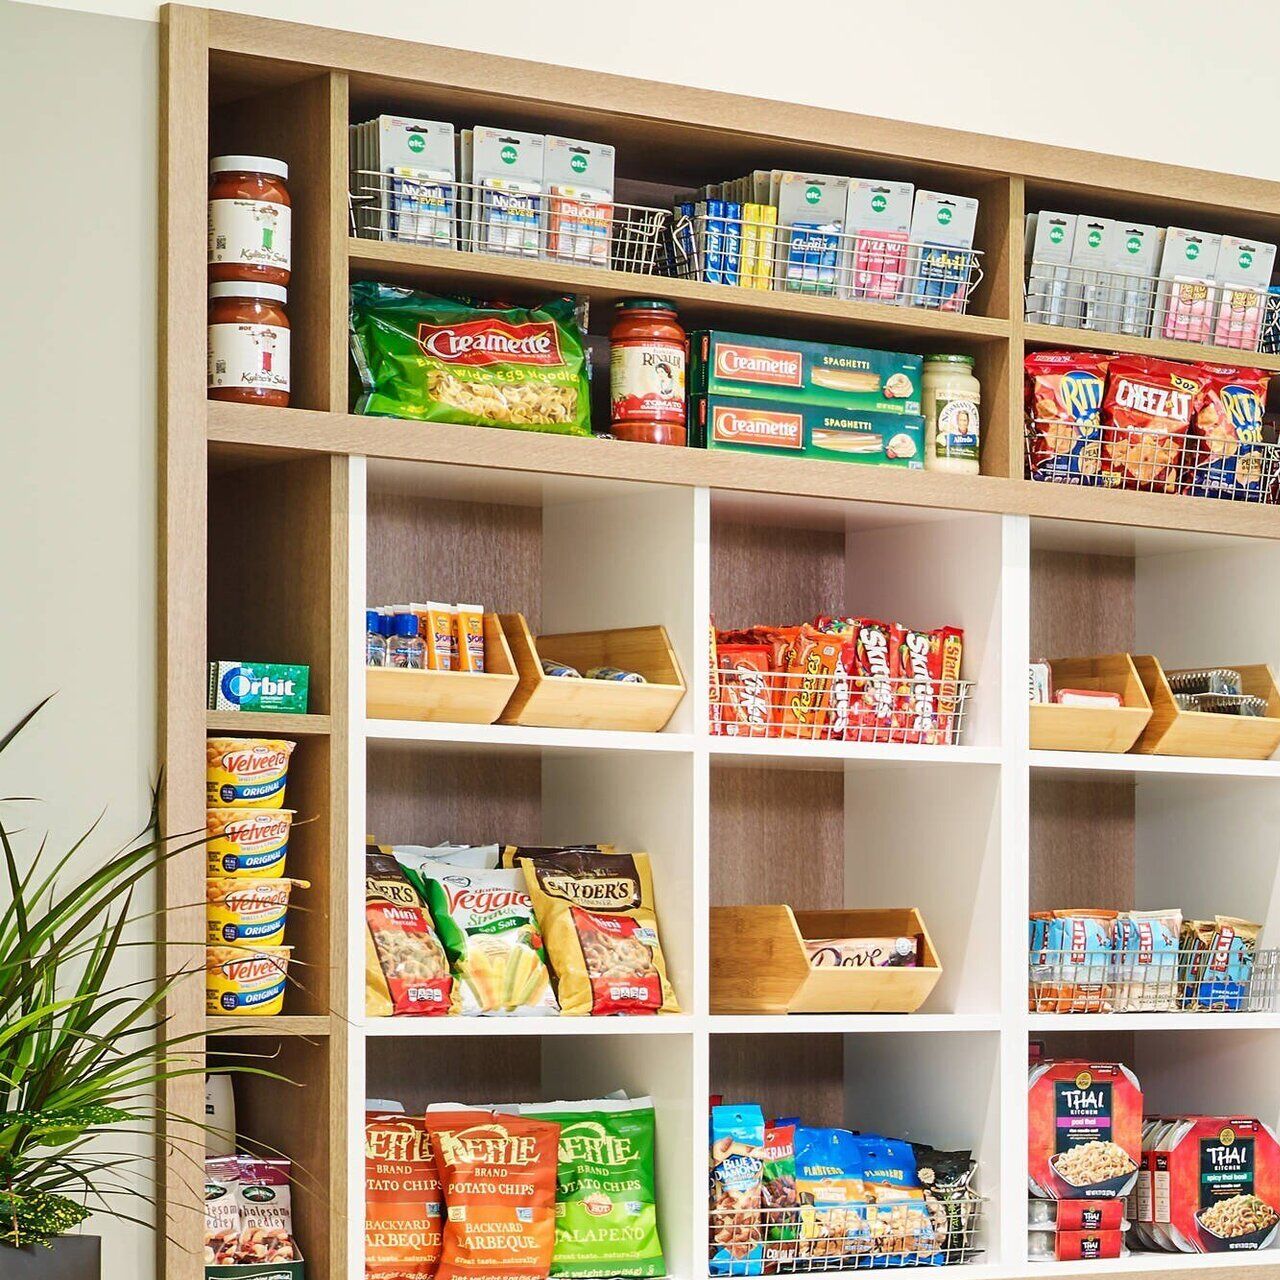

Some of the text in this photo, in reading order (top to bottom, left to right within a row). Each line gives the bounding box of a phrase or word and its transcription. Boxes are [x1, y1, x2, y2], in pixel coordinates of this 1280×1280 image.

[424, 330, 551, 359] Creamette
[717, 349, 798, 376] Creamette
[823, 356, 870, 369] SPAGHETTI
[497, 369, 524, 382] Egg
[718, 412, 798, 438] Creamette
[824, 417, 872, 430] SPAGHETTI
[237, 672, 296, 697] Orbit
[226, 749, 286, 774] Velveeta
[242, 782, 280, 798] ORIGINAL
[230, 820, 288, 844] Velveeta
[245, 851, 282, 866] ORIGINAL
[229, 889, 287, 912] Velveeta
[383, 907, 417, 921] Mini
[244, 922, 282, 936] ORIGINAL
[496, 919, 517, 929] Salt
[226, 959, 286, 981] Velveeta
[243, 988, 281, 1003] ORIGINAL
[1062, 1090, 1104, 1108] THAI
[433, 1124, 541, 1168] KETTLE
[1206, 1147, 1246, 1165] THAI
[377, 1165, 412, 1175] BRAND
[577, 1165, 610, 1176] BRAND
[723, 1159, 747, 1169] BLUE
[475, 1169, 508, 1178] BRAND
[448, 1183, 535, 1195] POTATO CHIPS
[603, 1180, 641, 1192] CHIPS
[1084, 1211, 1100, 1221] THAI
[465, 1222, 523, 1234] BACKYARD
[366, 1233, 441, 1250] ARBEQUE
[1082, 1241, 1098, 1250] THAI
